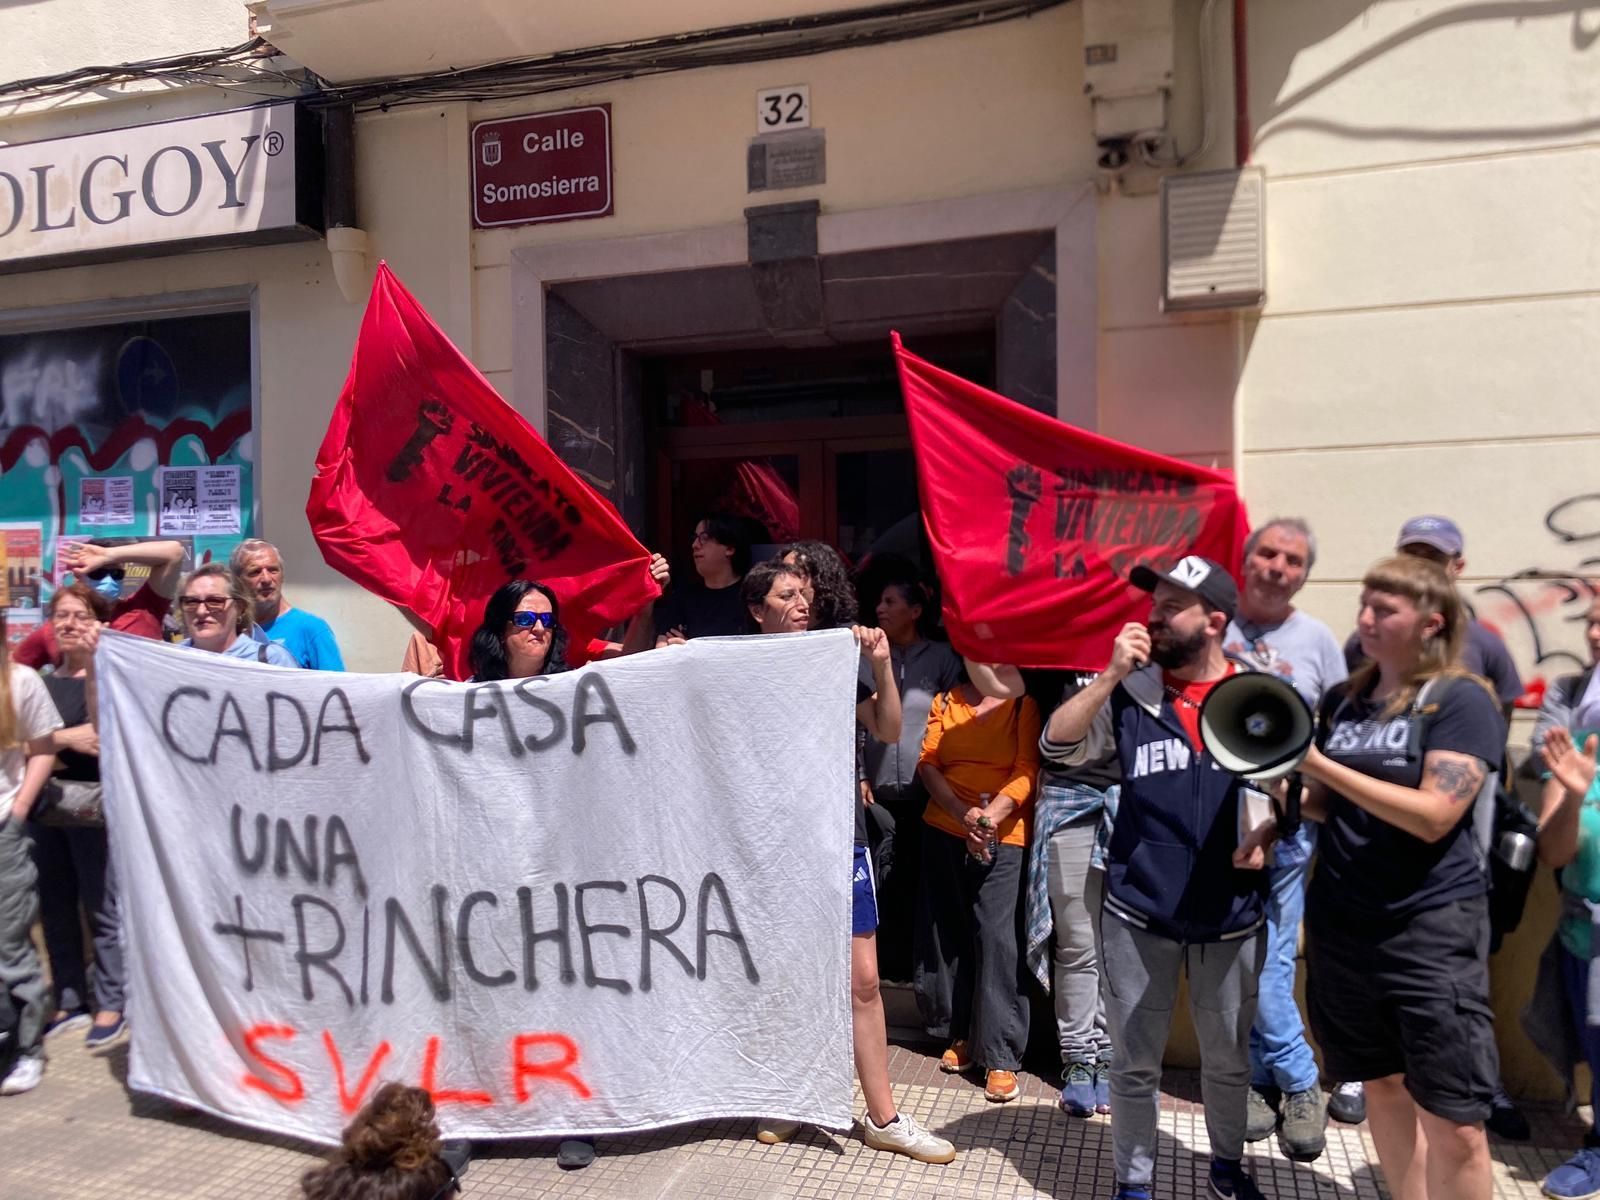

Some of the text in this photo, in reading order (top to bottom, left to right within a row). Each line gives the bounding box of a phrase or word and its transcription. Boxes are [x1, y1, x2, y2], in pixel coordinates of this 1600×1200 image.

[764, 93, 803, 126] 32
[523, 128, 584, 153] Calle
[483, 175, 600, 204] Somosierra
[1055, 493, 1203, 550] VIVIENDA
[1055, 552, 1088, 578] LA
[161, 672, 636, 774] CADA CASA
[1133, 737, 1192, 778] NEW
[231, 803, 368, 901] UNA
